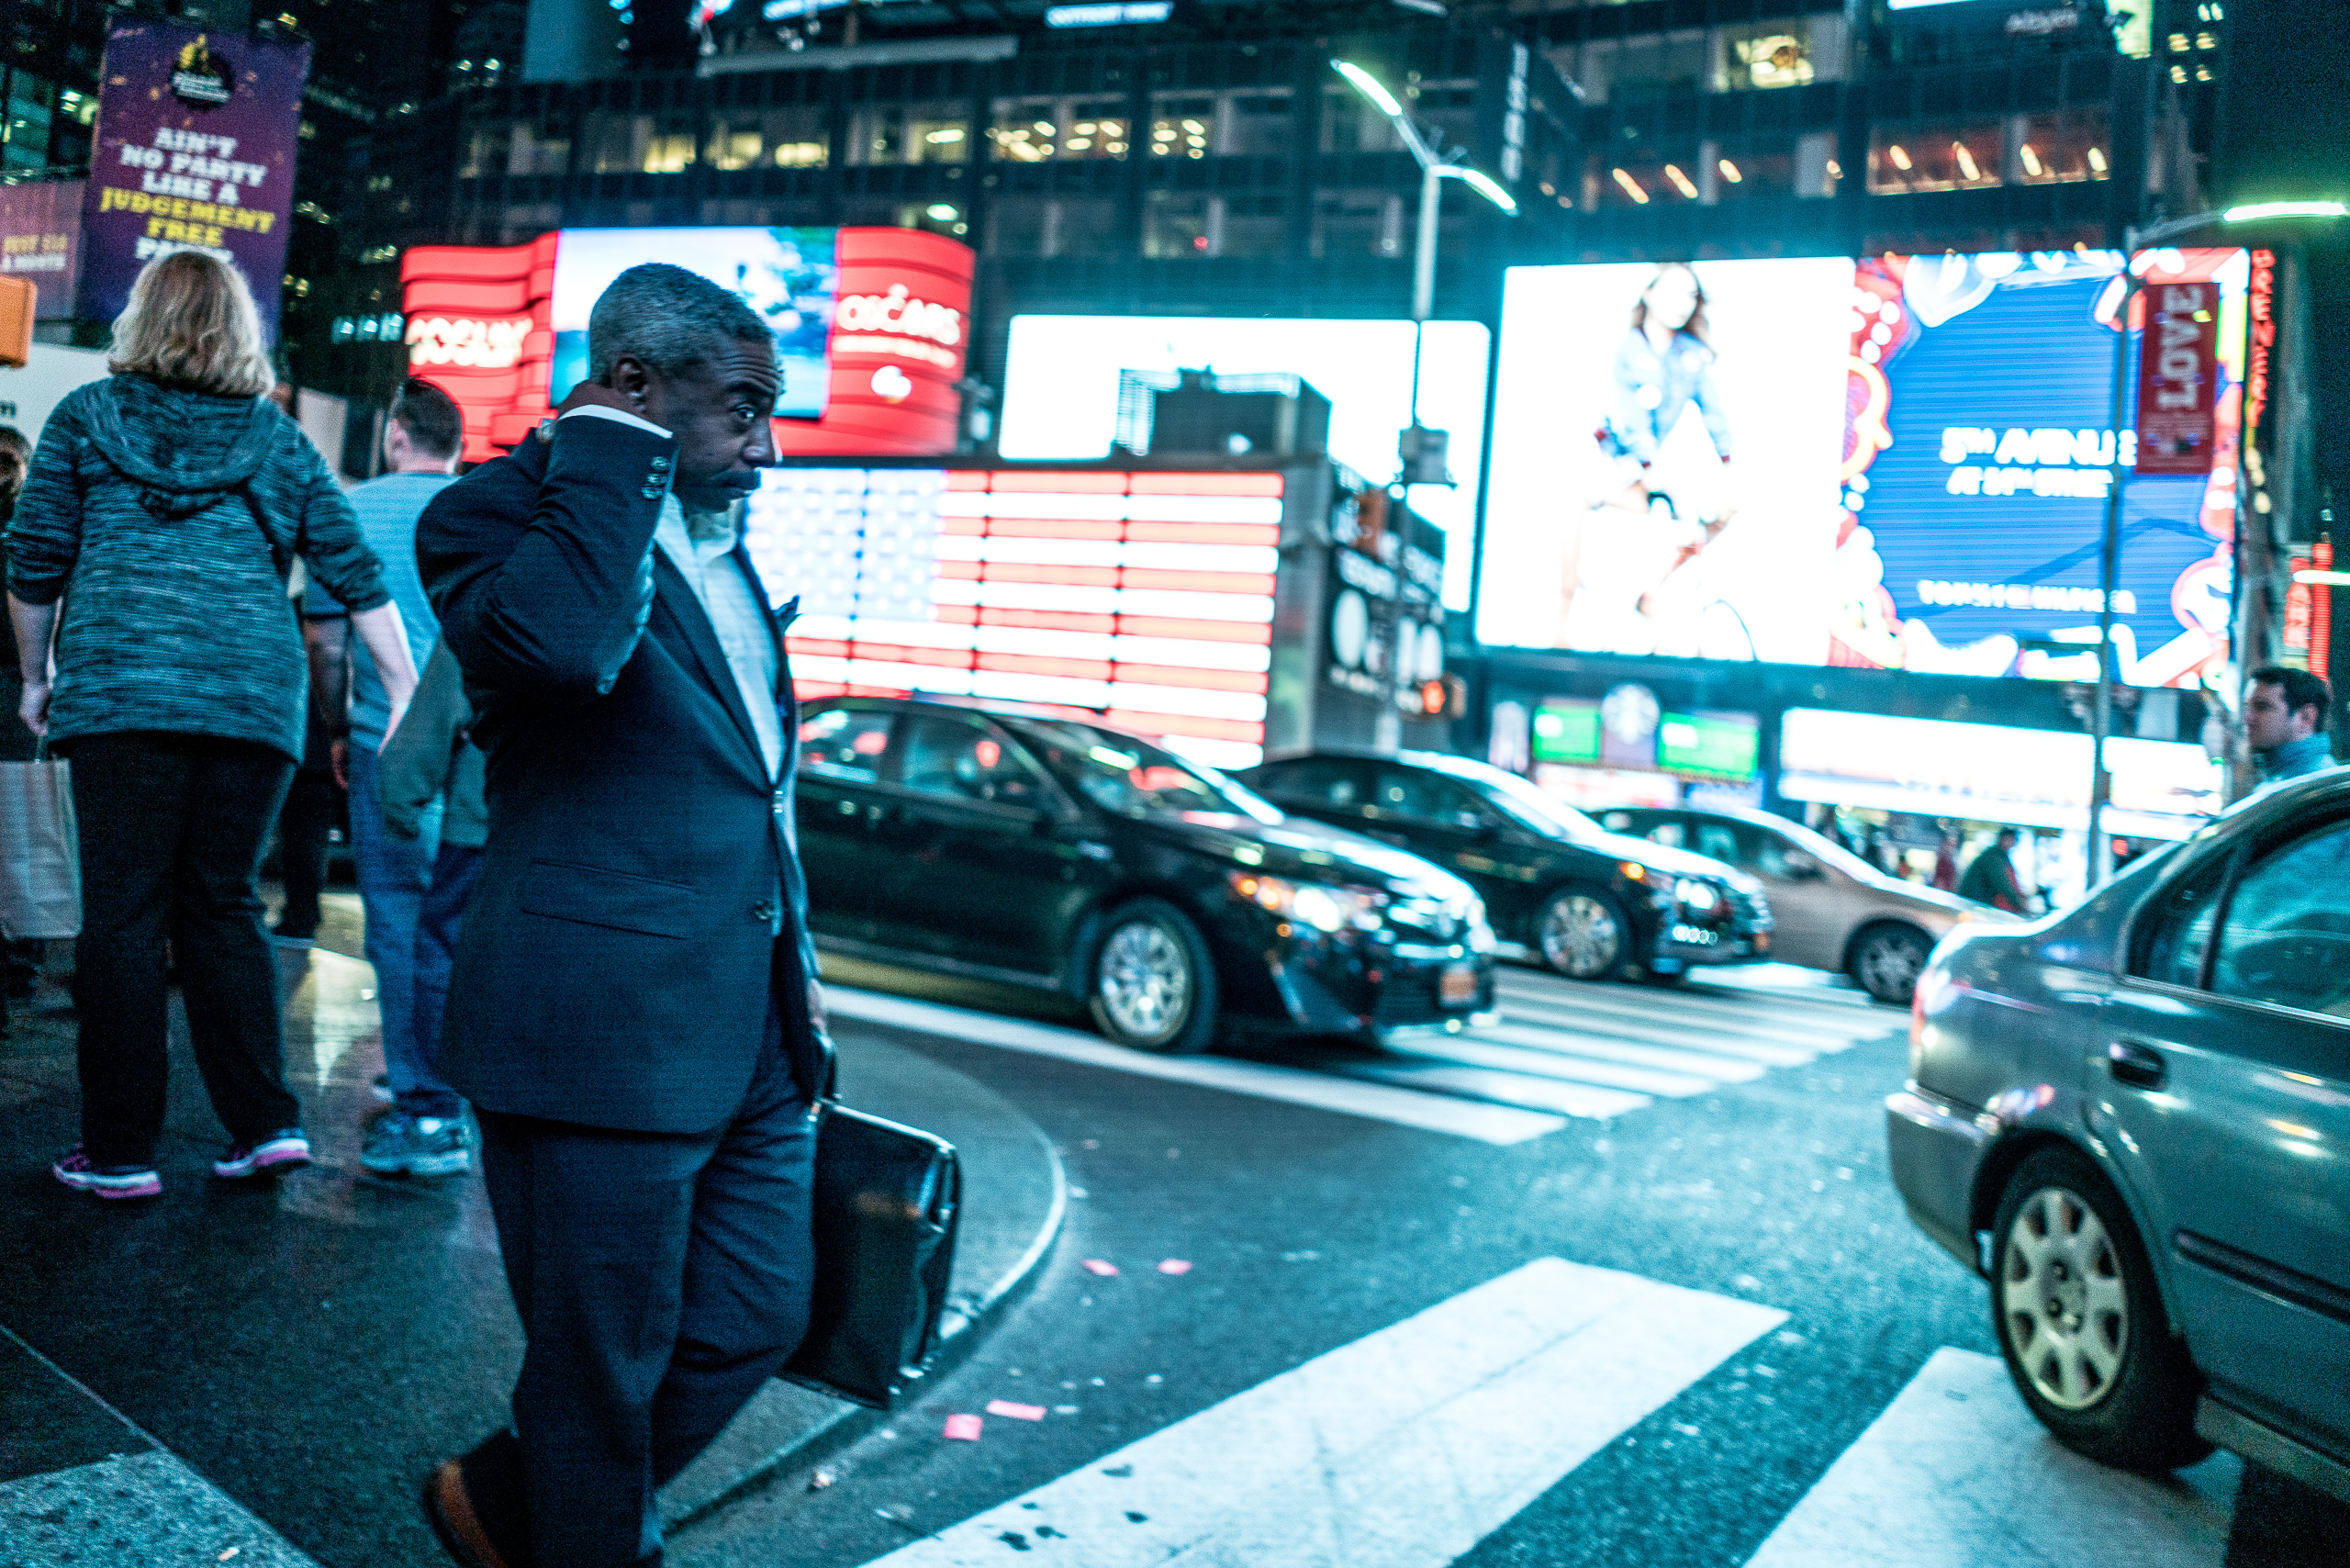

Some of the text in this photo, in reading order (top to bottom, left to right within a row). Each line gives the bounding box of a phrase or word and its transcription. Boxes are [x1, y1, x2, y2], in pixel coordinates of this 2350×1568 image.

[153, 127, 239, 159] AIN'T
[120, 144, 269, 188] NO PARTY
[142, 170, 240, 206] LIKE A
[98, 186, 276, 235] JUDGEMENT
[146, 217, 225, 247] FREE
[835, 283, 960, 345] OSCARS
[2157, 285, 2203, 411] LOVE
[1994, 427, 2138, 466] AVENUE
